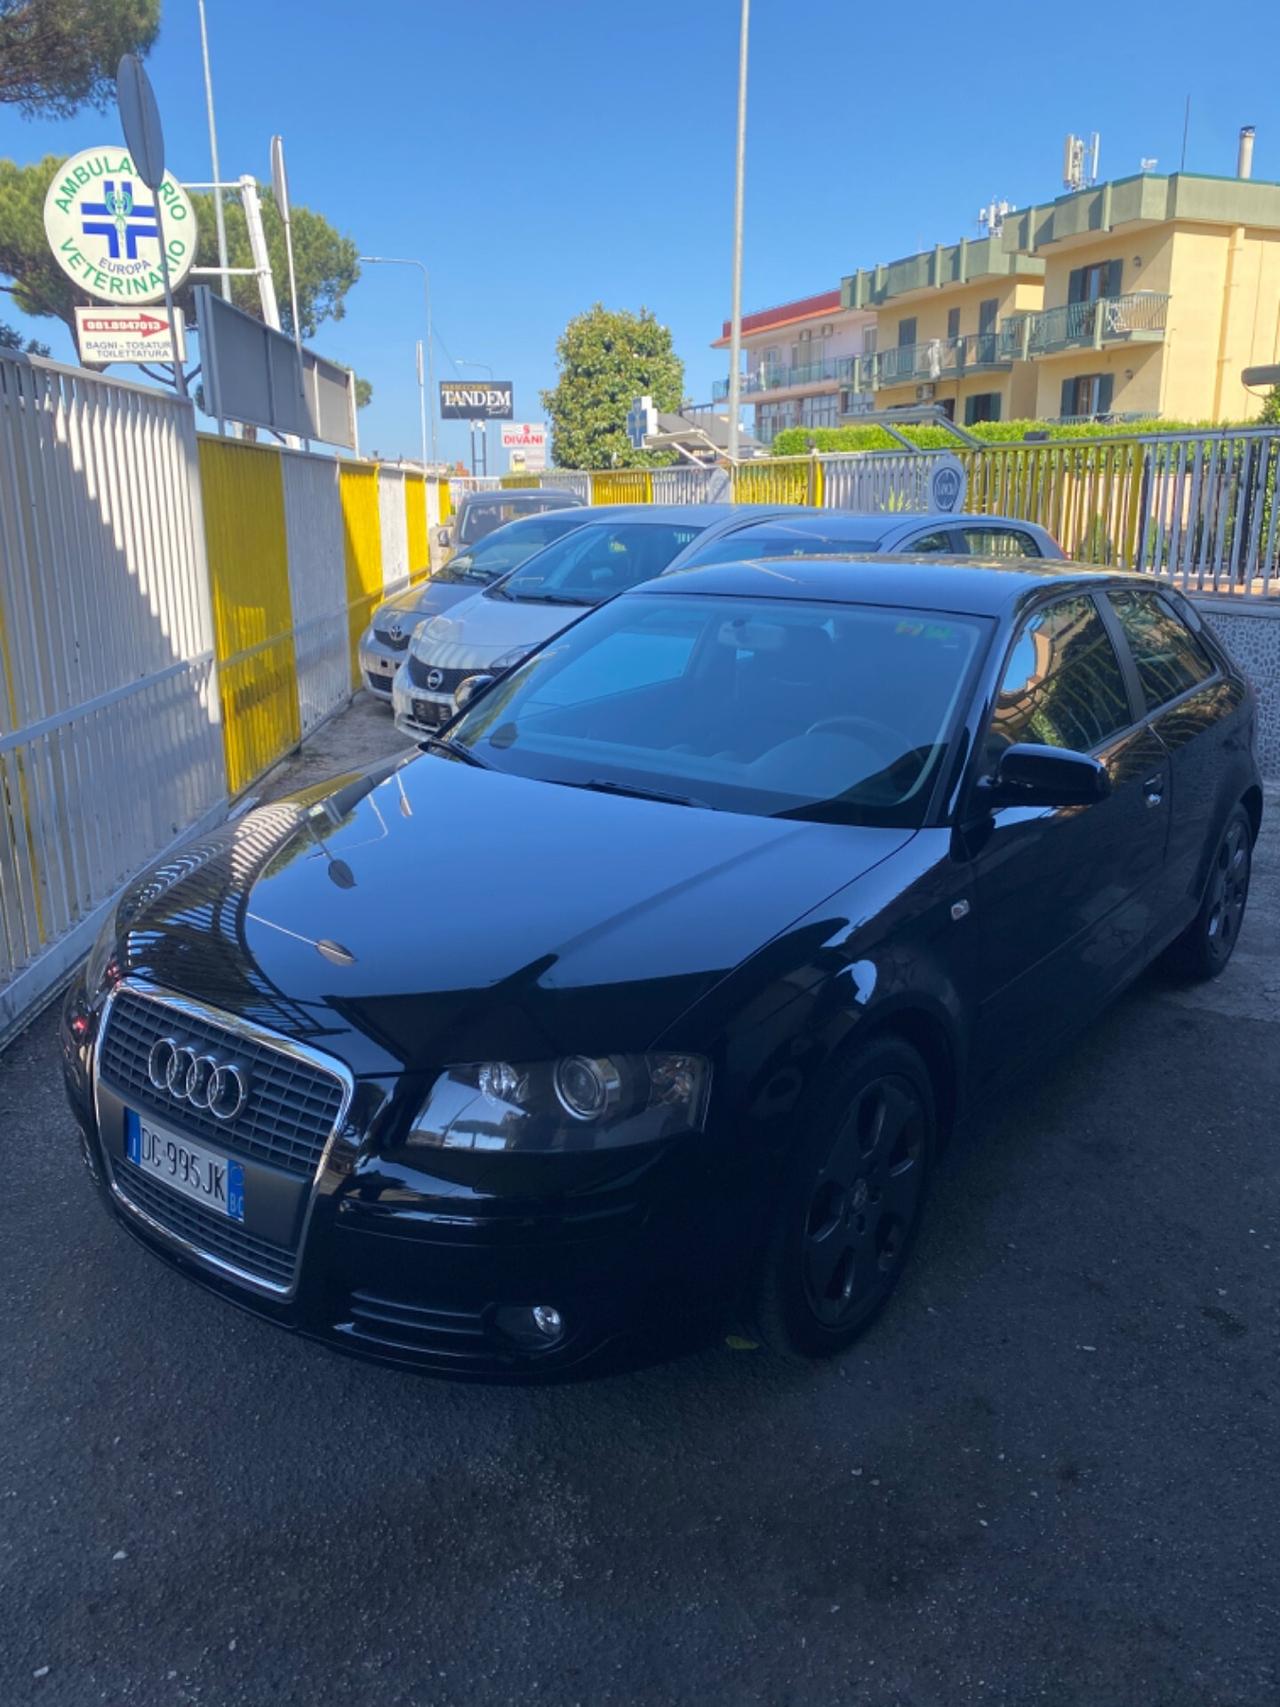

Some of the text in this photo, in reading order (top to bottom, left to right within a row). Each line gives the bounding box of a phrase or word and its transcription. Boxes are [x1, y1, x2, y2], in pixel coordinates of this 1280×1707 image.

[55, 156, 187, 221] AMBULARIO
[98, 257, 151, 275] EUROPA
[86, 341, 118, 350] BAGNI
[126, 341, 173, 350] TOSATUR
[97, 349, 170, 358] TOILETTATURA
[441, 390, 511, 407] TANDEM
[504, 434, 543, 445] DIVANI
